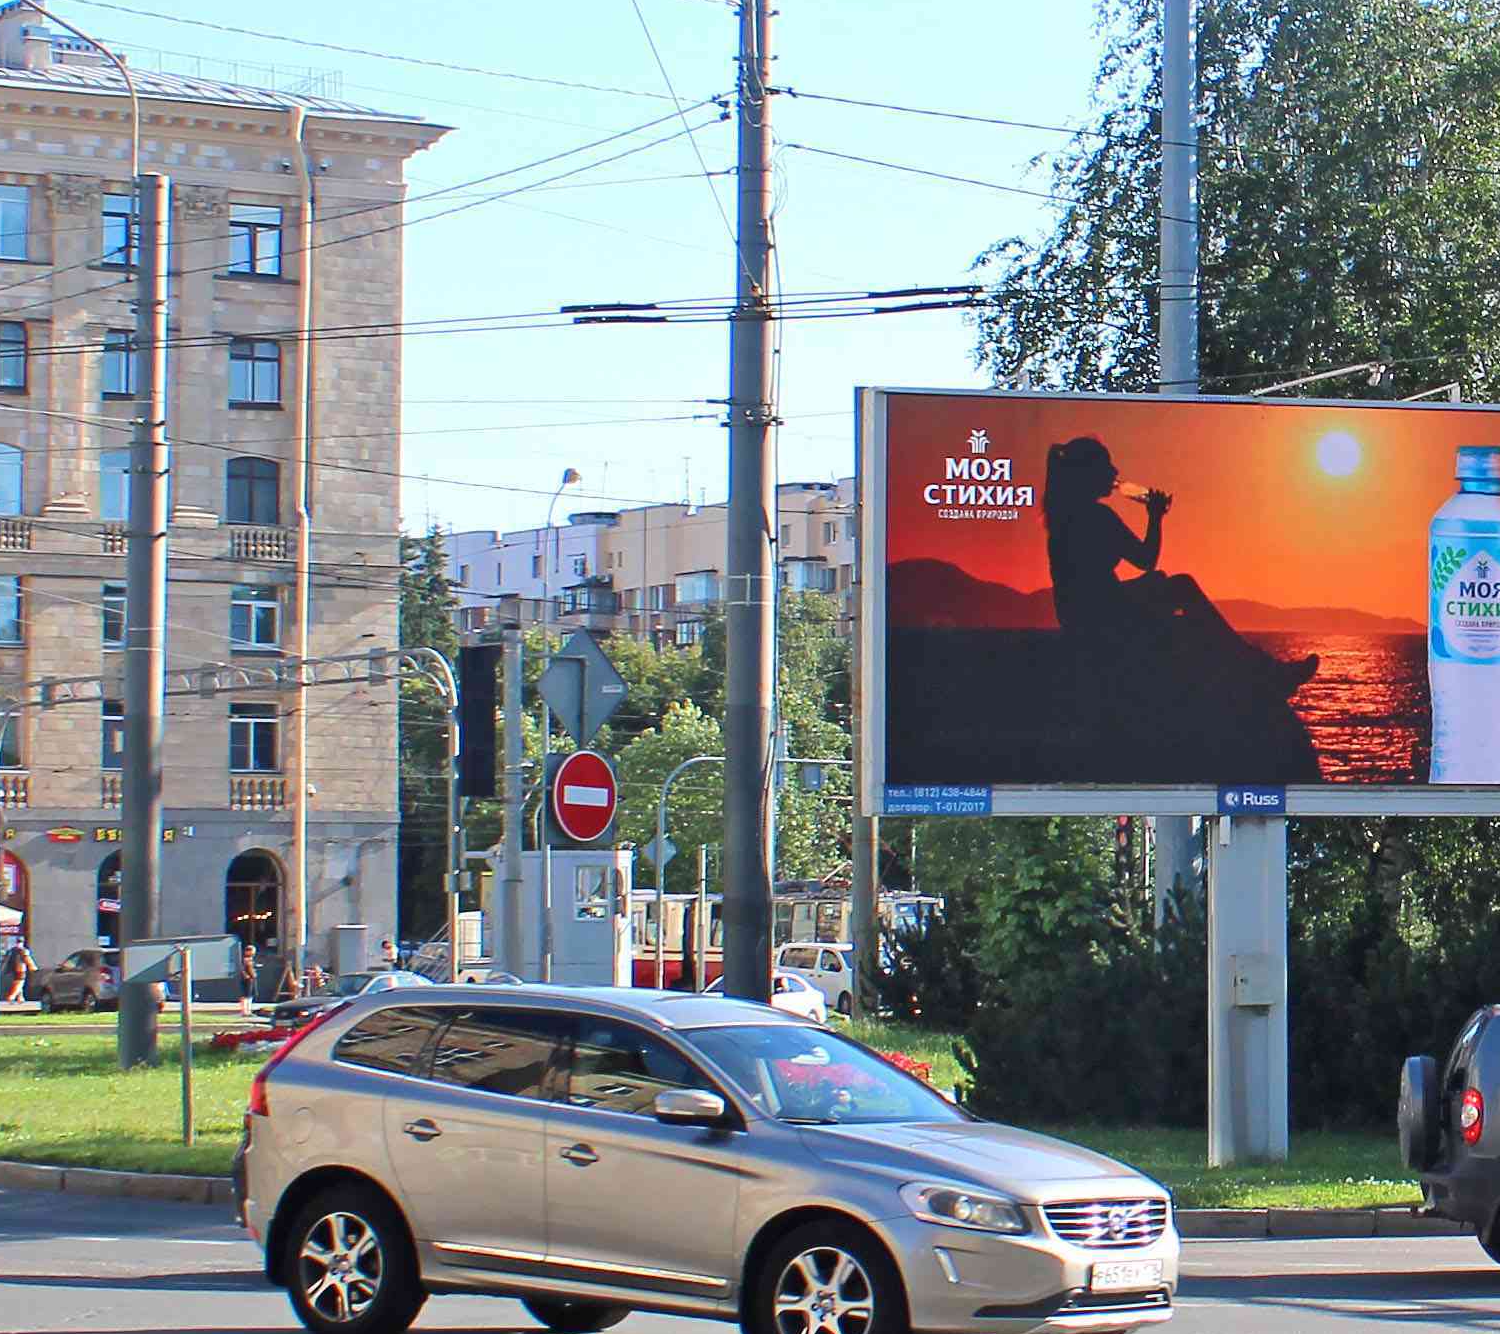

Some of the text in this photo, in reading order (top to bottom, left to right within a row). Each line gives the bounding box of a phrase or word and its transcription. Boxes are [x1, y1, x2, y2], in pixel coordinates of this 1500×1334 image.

[945, 457, 1011, 481] МОЯ
[923, 483, 1033, 506] СТИХИЯ
[1243, 791, 1279, 805] Russ
